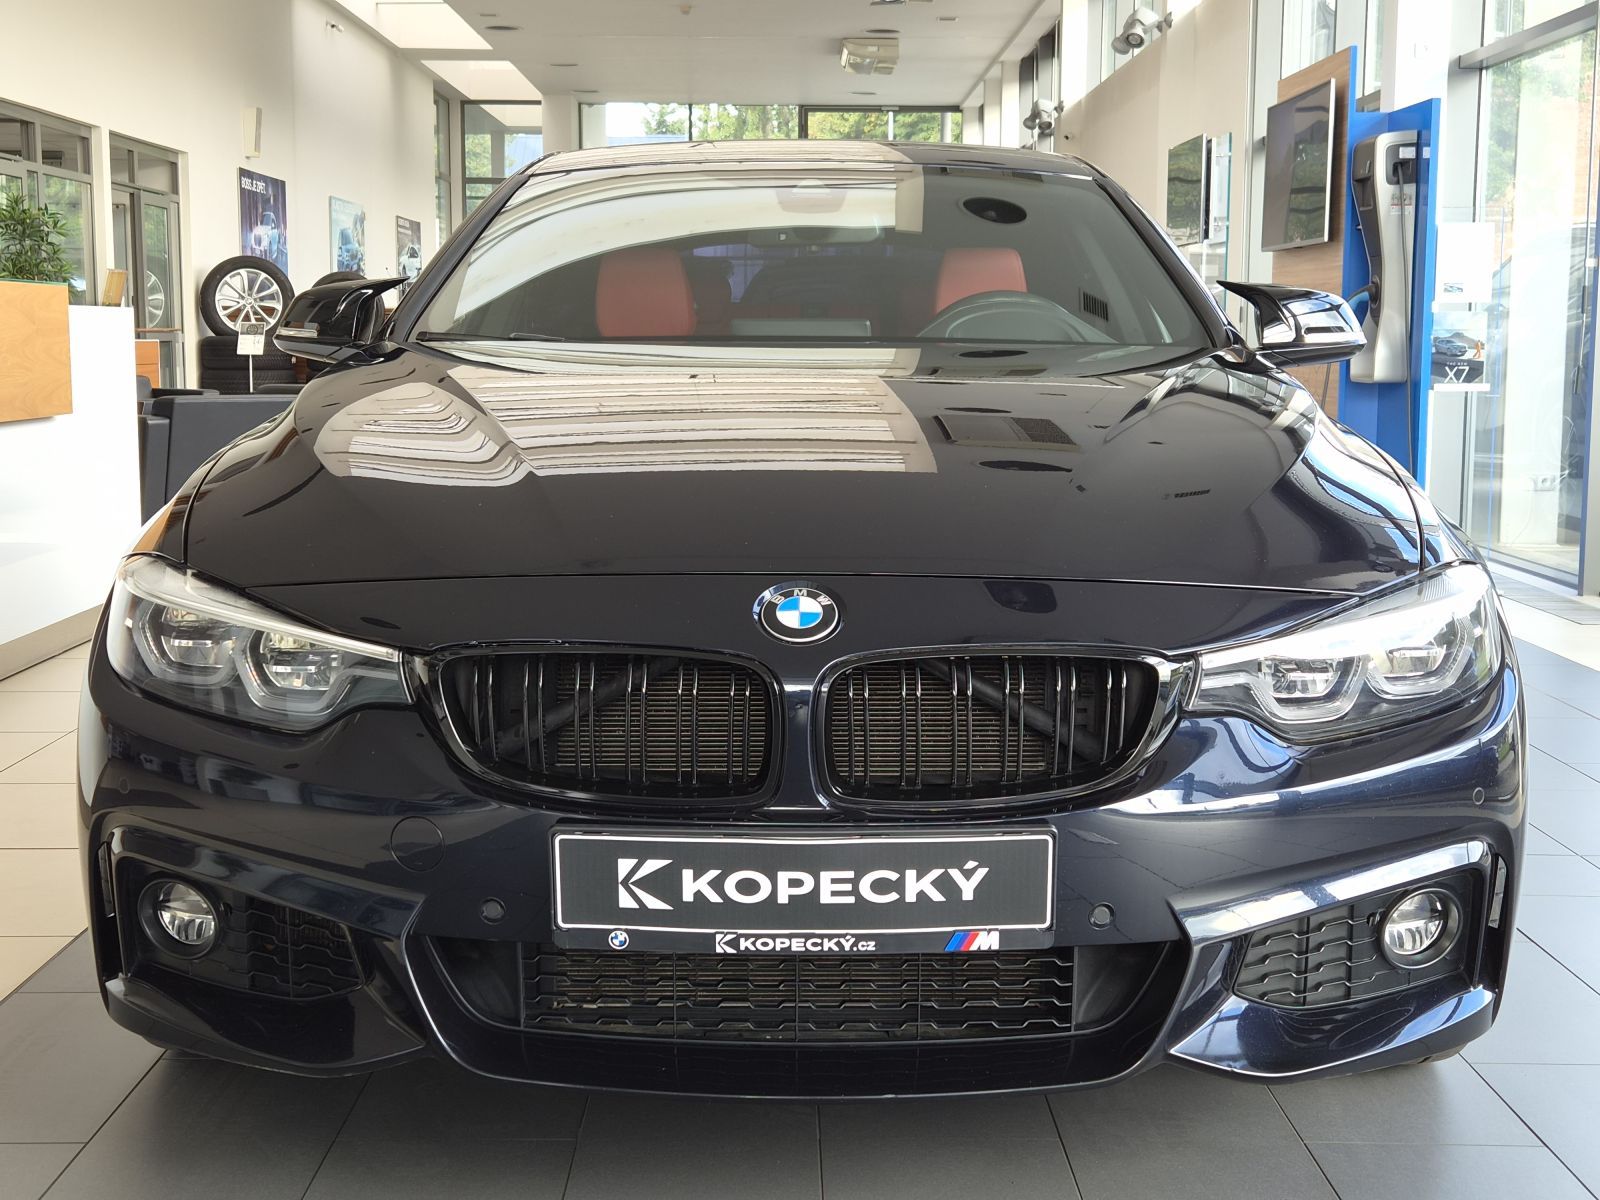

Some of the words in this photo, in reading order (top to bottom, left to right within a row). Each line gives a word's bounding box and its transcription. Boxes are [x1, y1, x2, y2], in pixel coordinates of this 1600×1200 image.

[241, 176, 252, 190] BOSS
[1444, 366, 1470, 383] X7
[770, 589, 832, 605] BMW
[682, 860, 990, 905] KOPECKÝ
[739, 935, 876, 952] KOPECKÝ.cz
